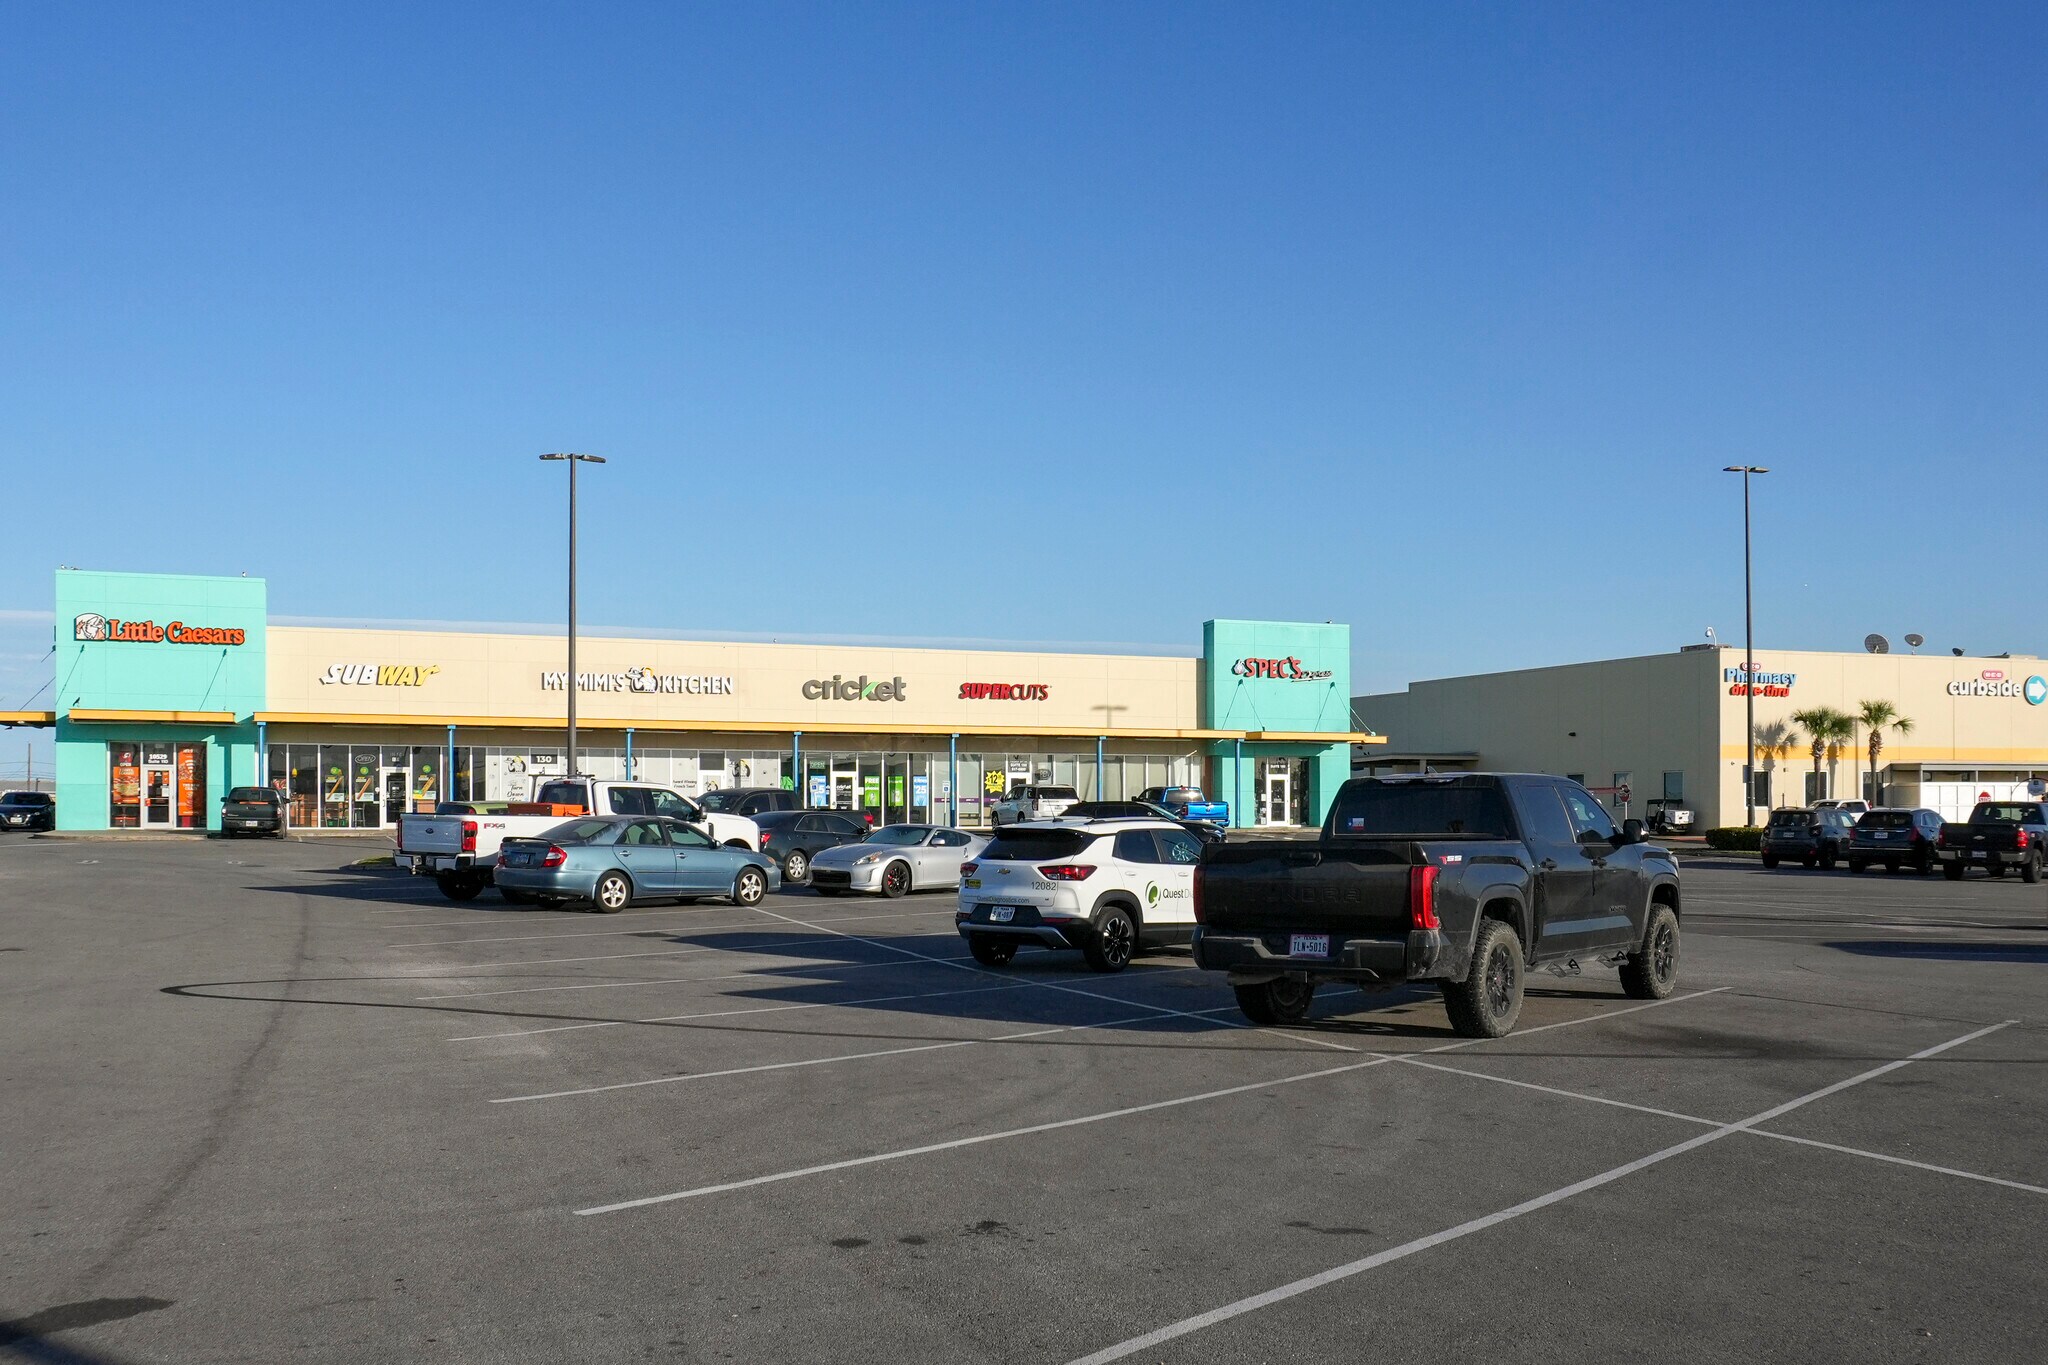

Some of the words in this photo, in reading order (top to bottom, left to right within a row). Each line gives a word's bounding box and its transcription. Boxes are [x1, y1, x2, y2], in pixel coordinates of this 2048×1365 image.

[108, 619, 164, 642] Little
[166, 621, 245, 645] Caesars
[319, 664, 440, 686] SUBWAY
[1243, 656, 1301, 679] SPEC'S
[542, 672, 568, 690] MY
[575, 673, 625, 692] MIMI'S
[660, 675, 734, 694] KITCHEN
[802, 674, 906, 701] cricket
[958, 682, 1049, 701] SUPERCUTS
[1729, 684, 1790, 697] drie-thru
[1947, 679, 2022, 697] curbside
[1031, 882, 1056, 890] 12082
[1162, 888, 1184, 899] Quest
